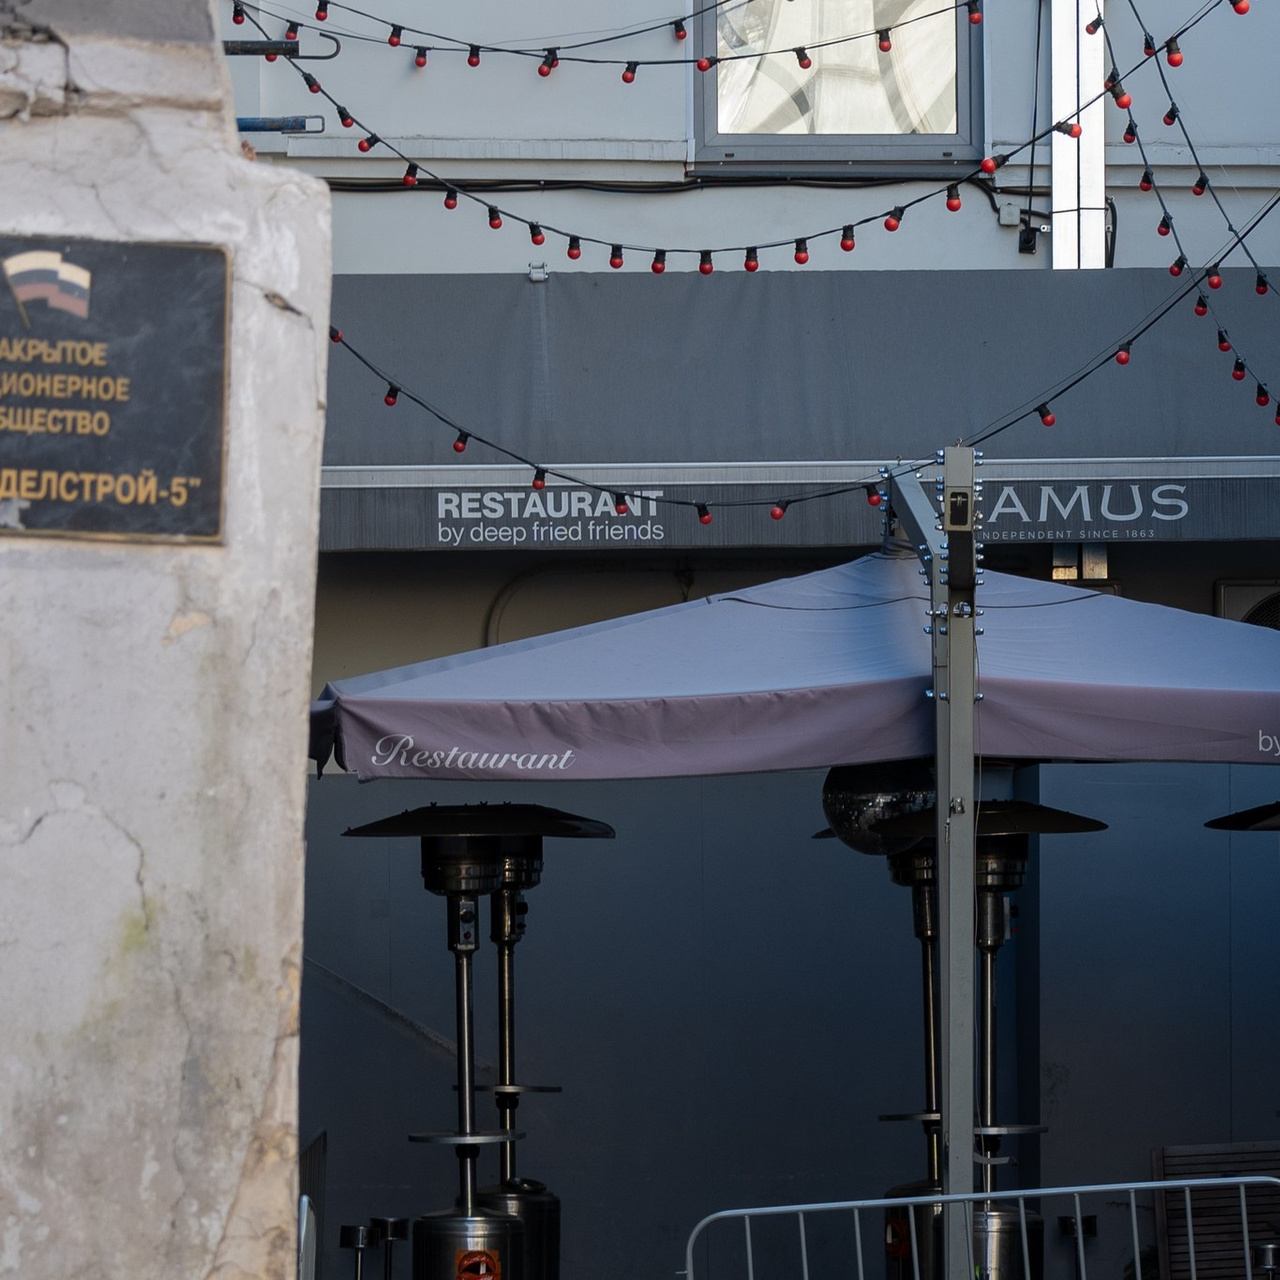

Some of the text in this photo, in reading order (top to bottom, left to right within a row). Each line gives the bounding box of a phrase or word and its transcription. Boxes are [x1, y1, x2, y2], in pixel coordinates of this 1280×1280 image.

[0, 372, 130, 401] ИОНЕРНОЕ
[438, 490, 665, 519] RESTAURANT
[940, 484, 1189, 523] AMUS
[438, 521, 665, 546] by deep fried friends
[981, 529, 1156, 541] NDEPENDENT SINCE 1863
[371, 733, 577, 770] Restaurant
